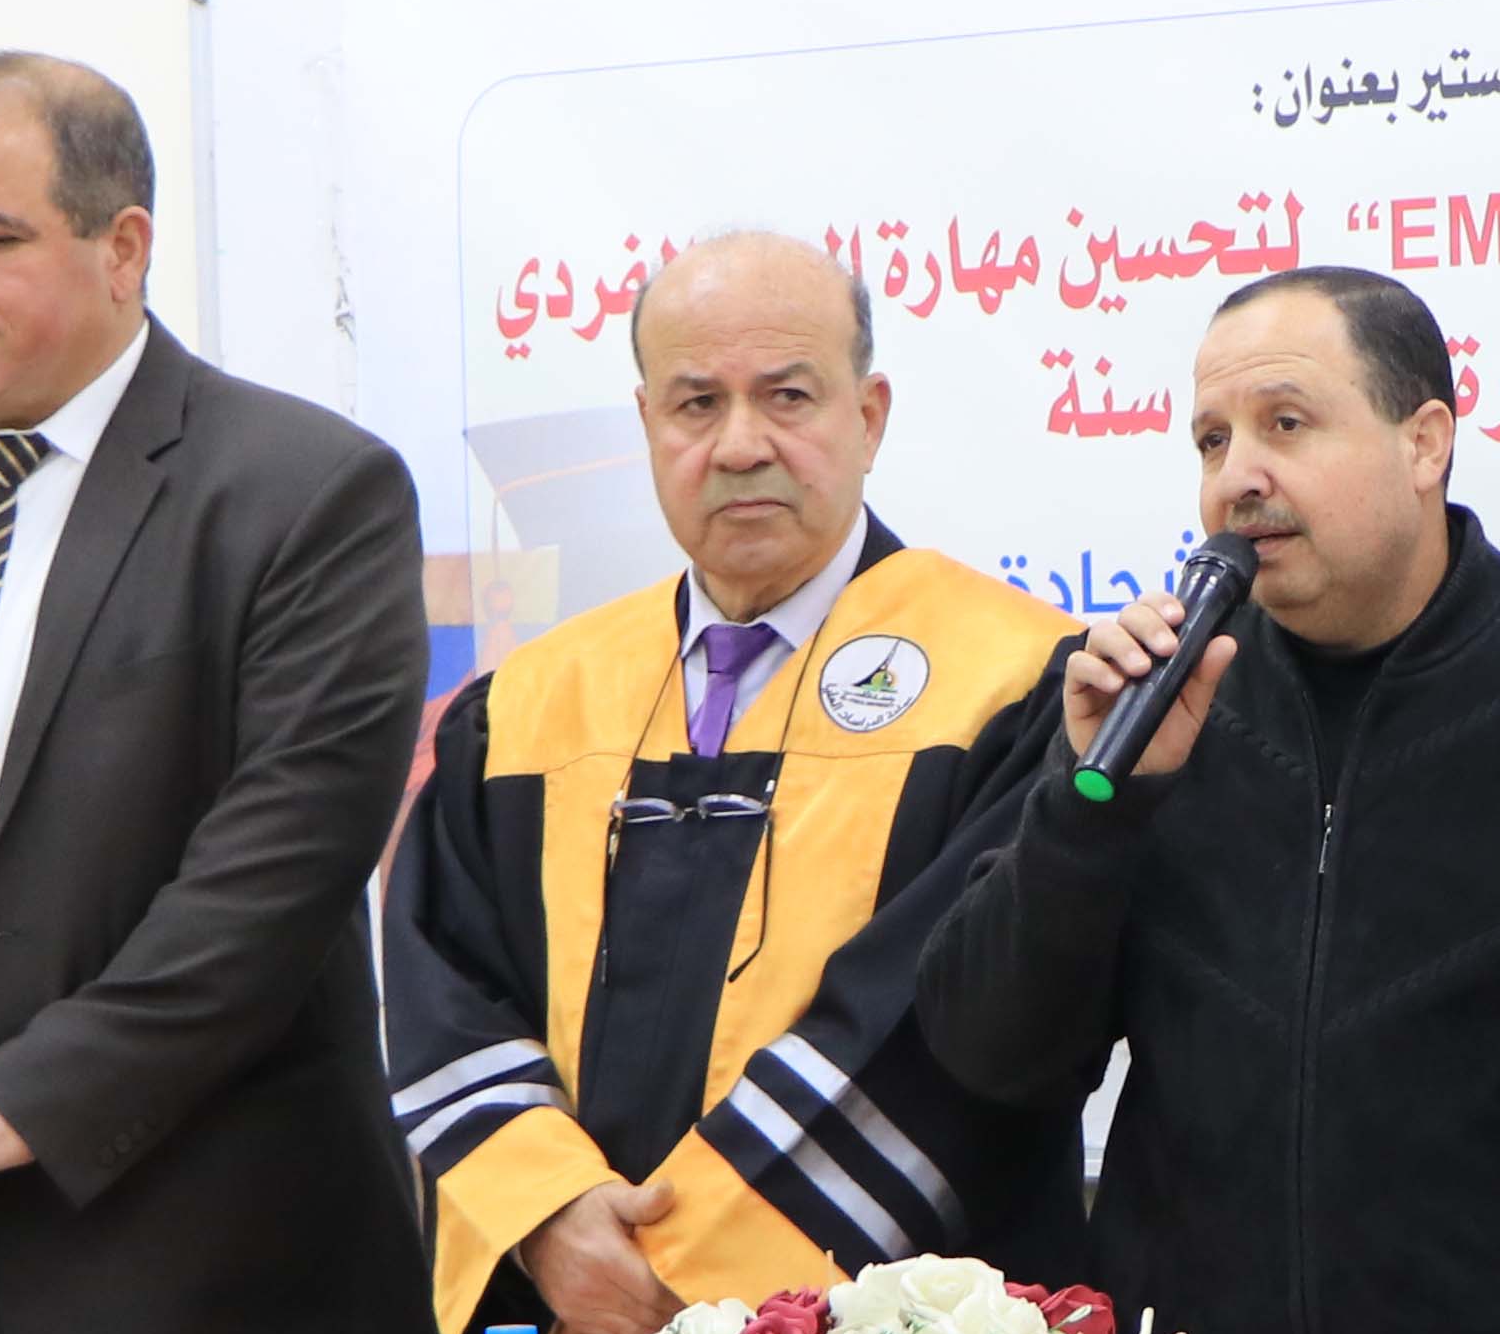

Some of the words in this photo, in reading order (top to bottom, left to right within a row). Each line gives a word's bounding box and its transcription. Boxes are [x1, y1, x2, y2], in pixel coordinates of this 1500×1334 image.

[883, 212, 1039, 319] مهارة
[1058, 189, 1305, 311] لتحسين
[1045, 349, 1172, 439] سنة
